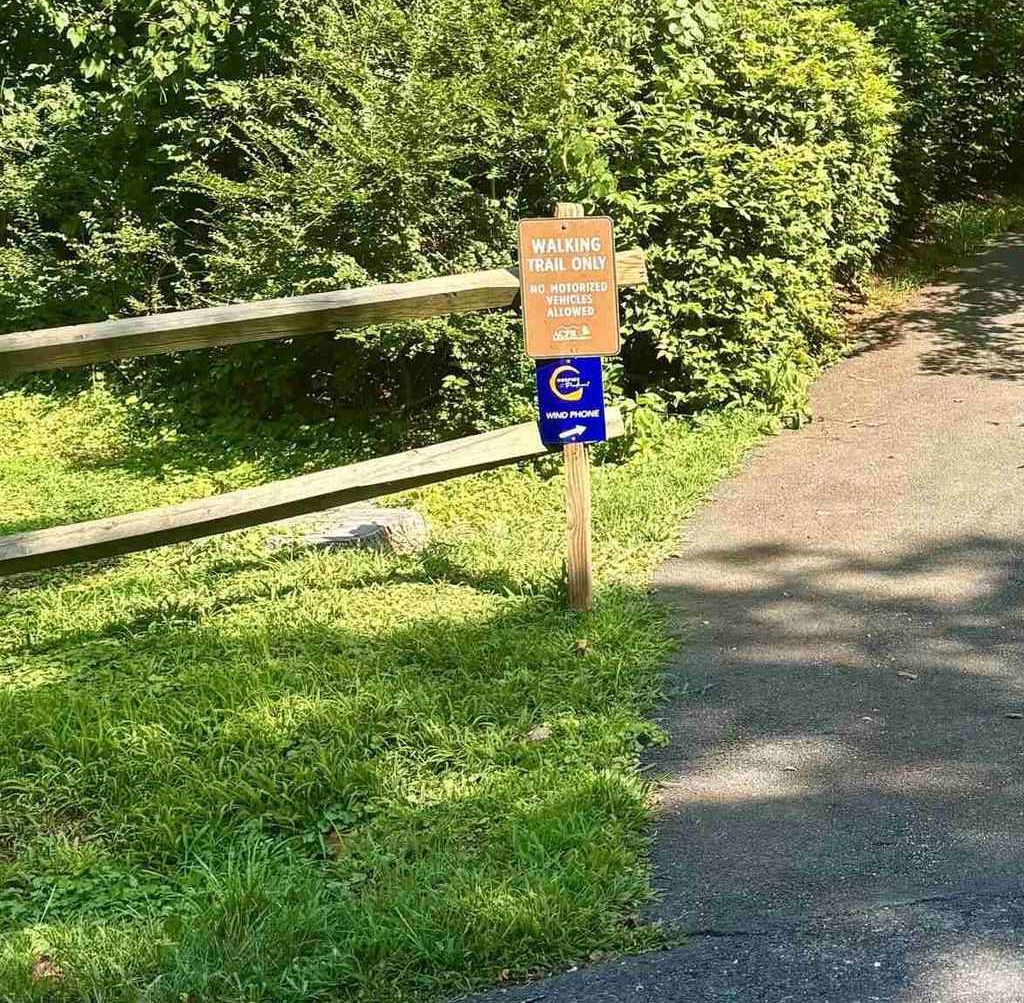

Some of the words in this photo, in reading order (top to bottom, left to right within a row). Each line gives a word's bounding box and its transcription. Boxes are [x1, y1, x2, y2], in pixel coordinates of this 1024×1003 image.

[531, 237, 601, 254] WALKING
[527, 257, 566, 272] TRAIL
[571, 256, 607, 271] ONLY
[530, 284, 545, 294] NO
[550, 282, 608, 293] MOTORIZED
[546, 295, 593, 305] VEHICLES
[547, 306, 595, 318] ALLOWED
[546, 411, 569, 419] WIND
[569, 409, 600, 418] PHONE
